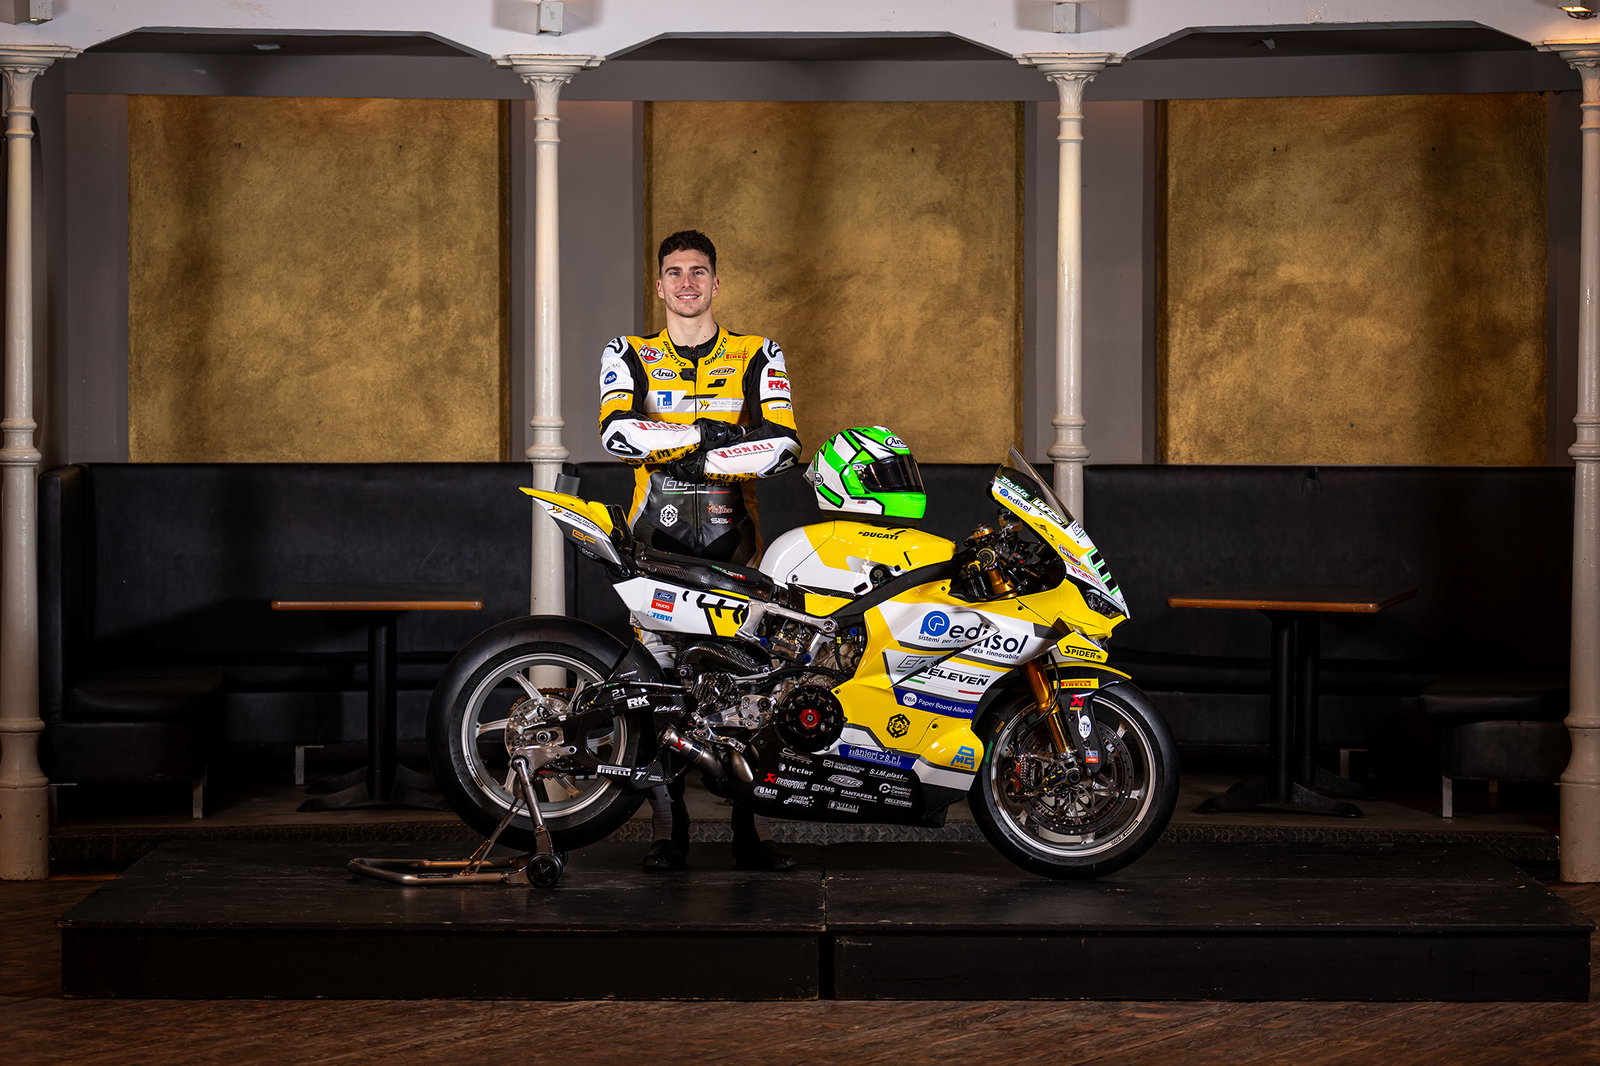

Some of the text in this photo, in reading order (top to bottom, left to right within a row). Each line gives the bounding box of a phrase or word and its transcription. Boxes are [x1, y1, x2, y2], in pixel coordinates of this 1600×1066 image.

[662, 340, 687, 367] GIMOTO
[704, 337, 728, 366] GIMOTO
[655, 369, 675, 378] Arai
[768, 380, 790, 391] RK
[715, 442, 774, 458] VIGNALI
[1007, 495, 1032, 512] edisol
[710, 517, 734, 525] SBK
[862, 531, 899, 540] DUCATI
[655, 602, 670, 610] TRUCKS
[652, 612, 673, 623] FERVI
[918, 634, 941, 643] sistemi
[985, 649, 1020, 660] rinnovabile
[1064, 645, 1099, 659] SPIDER
[927, 667, 989, 686] ELEVEN
[1061, 680, 1092, 688] PIRELLI
[626, 695, 650, 708] RK
[917, 698, 974, 714] Paper Board Alliance
[596, 764, 633, 777] PIRELLI
[759, 787, 778, 796] BMR
[820, 785, 836, 793] CMS
[840, 789, 873, 800] FANTAFER
